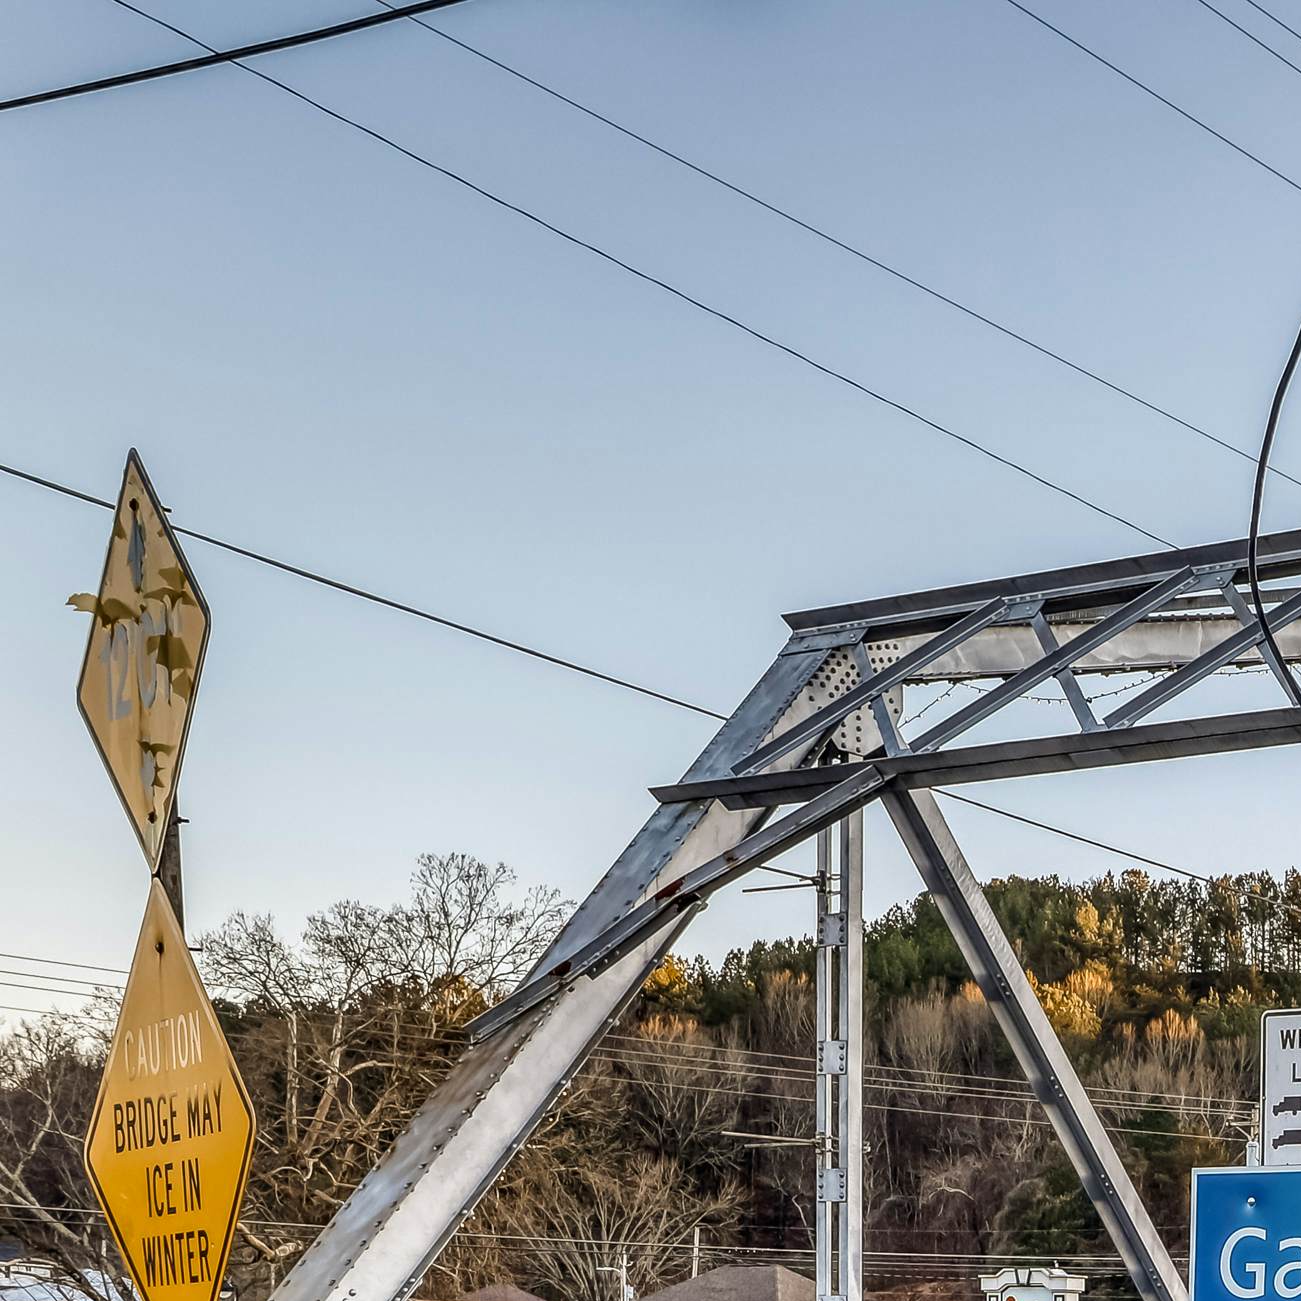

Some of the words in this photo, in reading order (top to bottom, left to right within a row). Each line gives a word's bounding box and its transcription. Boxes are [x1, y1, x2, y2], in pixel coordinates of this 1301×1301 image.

[125, 1010, 202, 1081] CAUTION
[114, 1090, 181, 1154] BRIDGE
[187, 1080, 222, 1138] MAY
[146, 1163, 177, 1218] ICE
[182, 1158, 202, 1212] IN
[142, 1230, 212, 1288] WINTER
